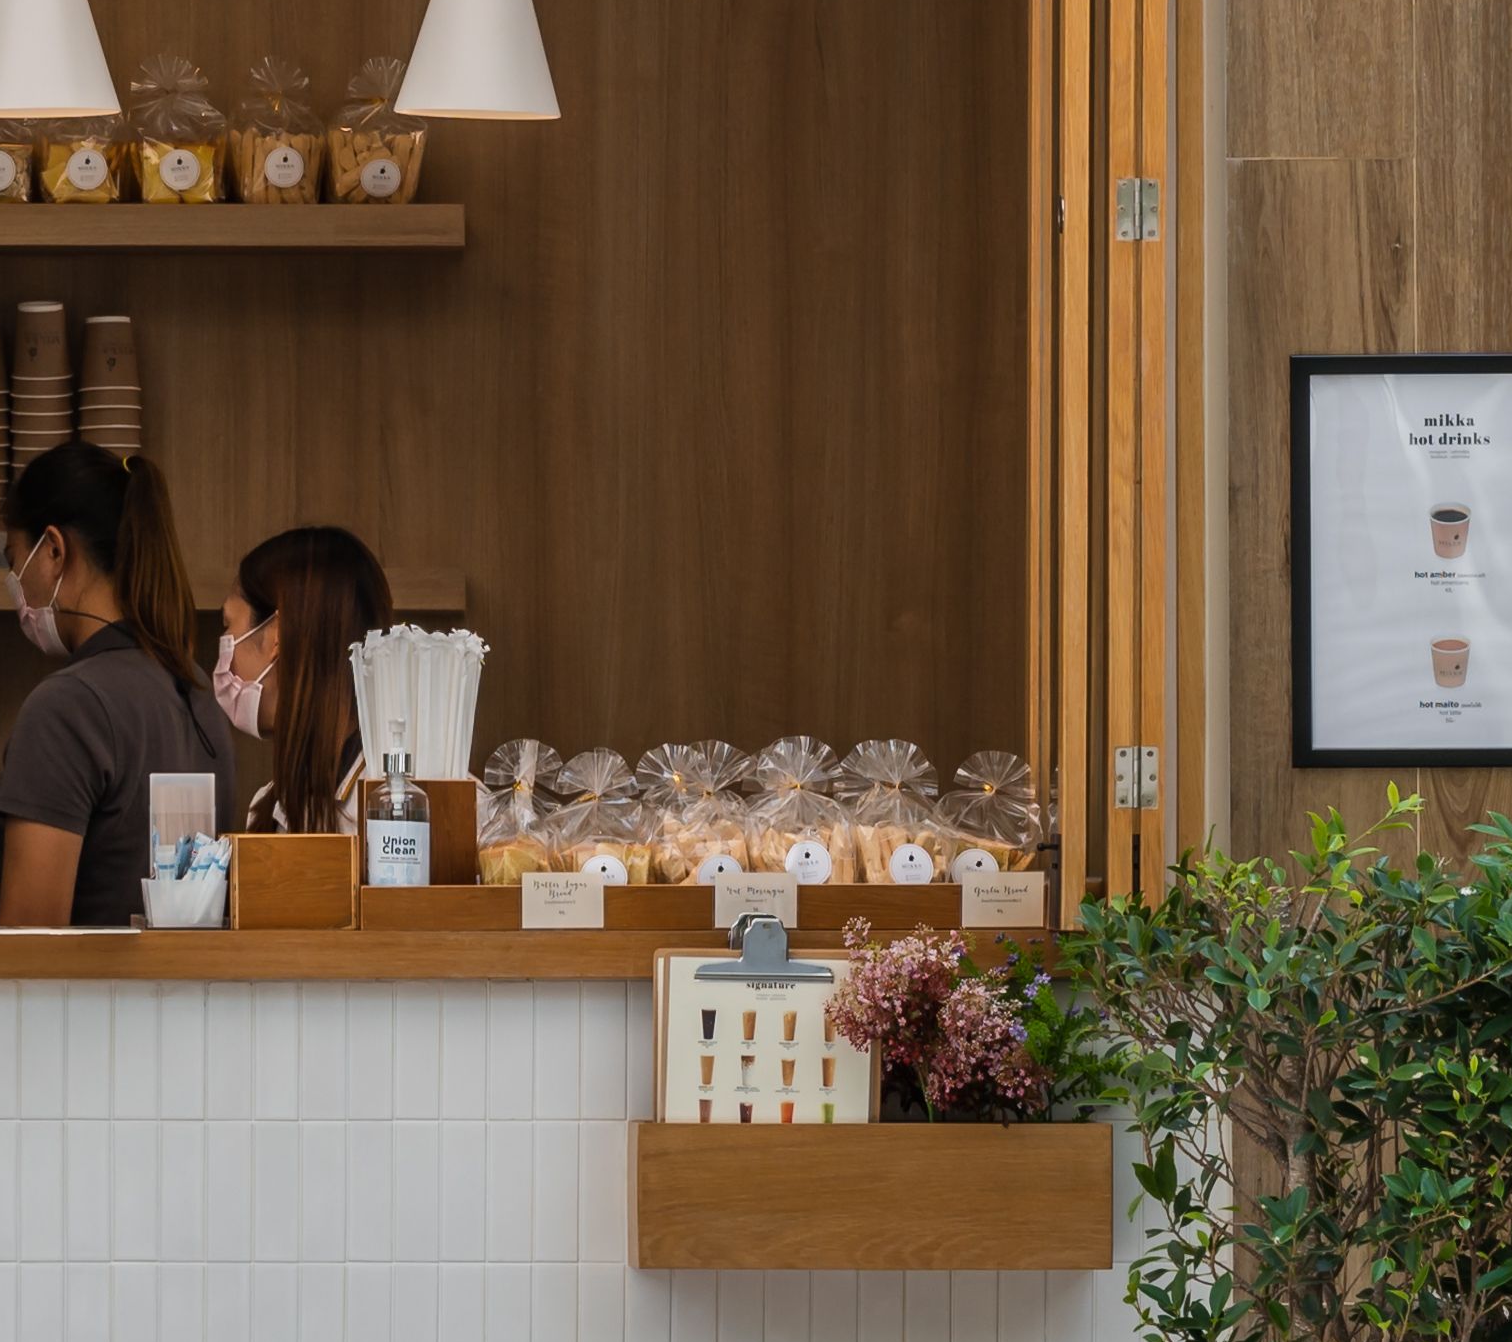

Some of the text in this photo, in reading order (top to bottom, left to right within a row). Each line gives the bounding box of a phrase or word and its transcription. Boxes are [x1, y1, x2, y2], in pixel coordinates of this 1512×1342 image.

[1424, 414, 1475, 427] mikka
[1409, 432, 1491, 446] hot drinks
[1414, 570, 1429, 579] hot
[1429, 570, 1456, 579] amber
[1419, 700, 1434, 709] hot
[1434, 700, 1460, 709] maito
[382, 835, 417, 846] Union
[382, 844, 416, 856] Clean
